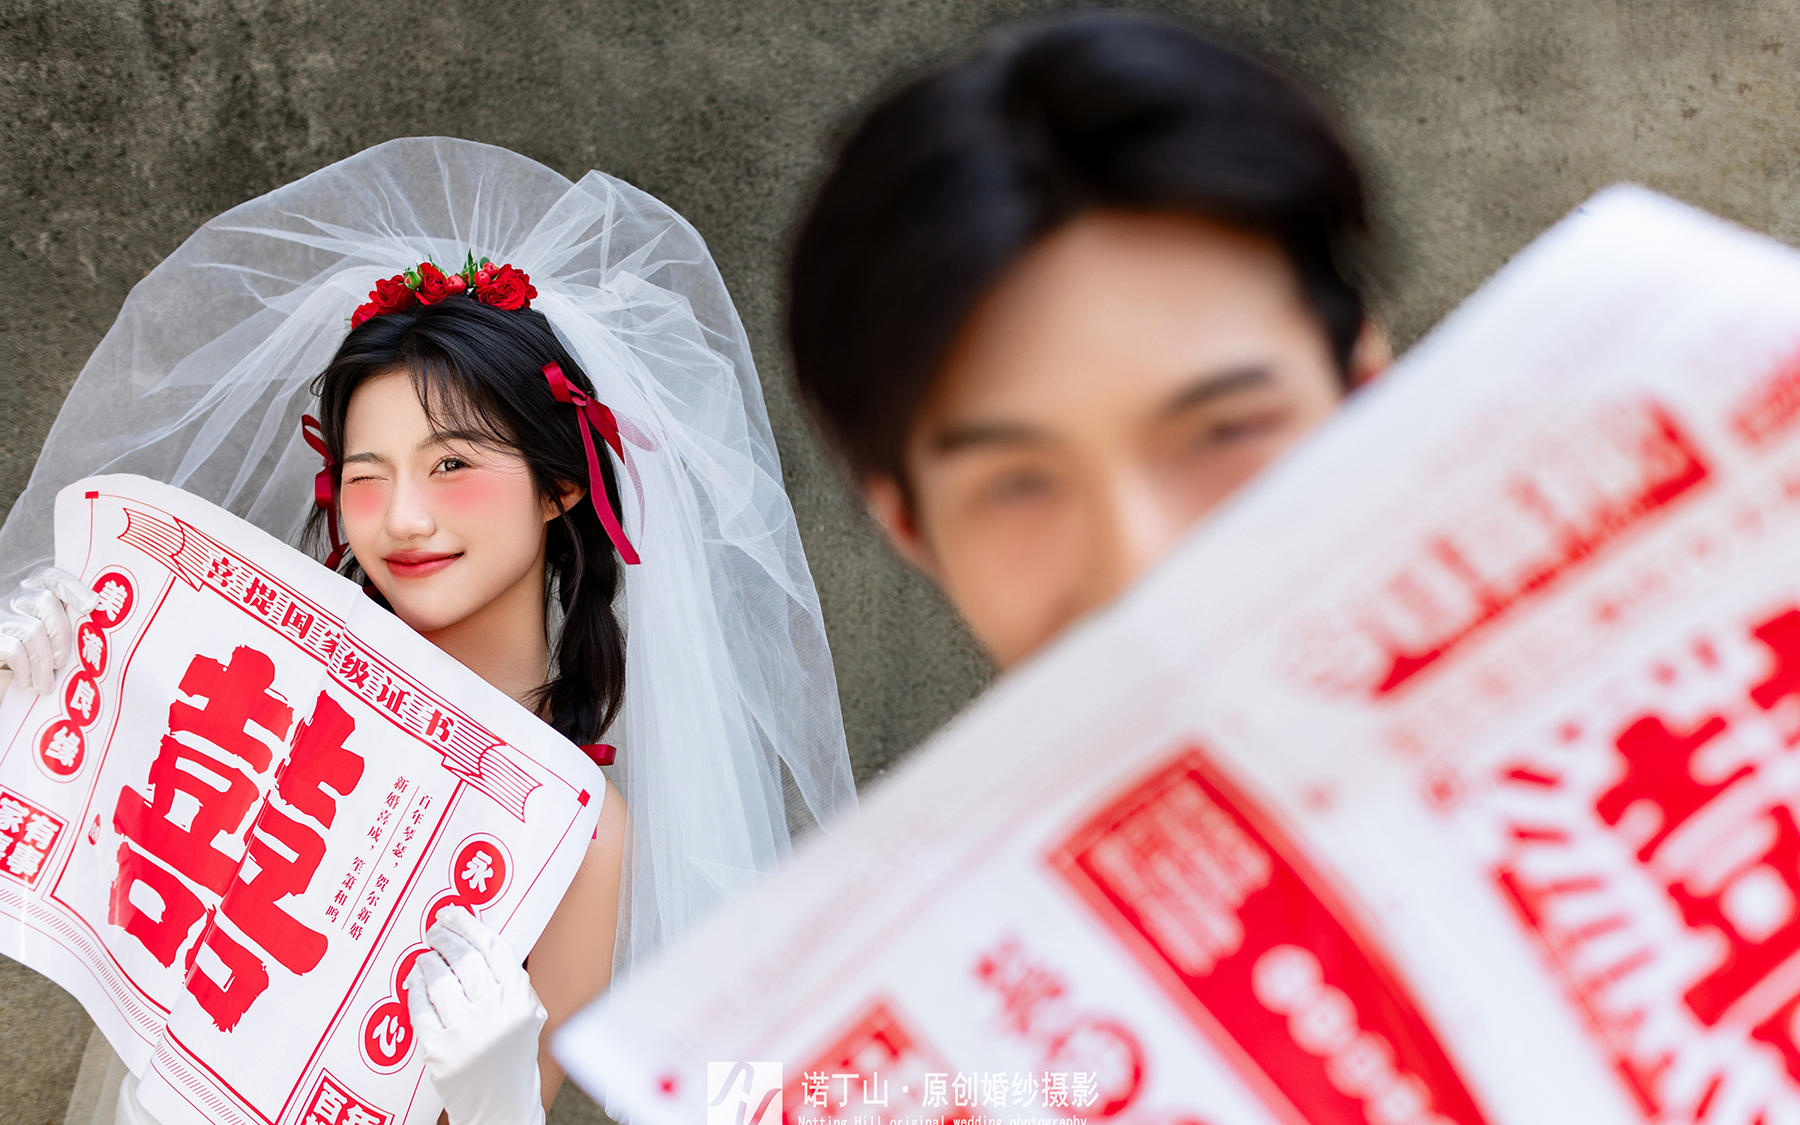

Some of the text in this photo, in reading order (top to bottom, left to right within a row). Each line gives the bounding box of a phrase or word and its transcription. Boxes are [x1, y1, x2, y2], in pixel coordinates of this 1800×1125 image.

[207, 557, 454, 742] 喜提国家级证书
[108, 644, 365, 1033] 囍
[372, 850, 493, 1058] 永心
